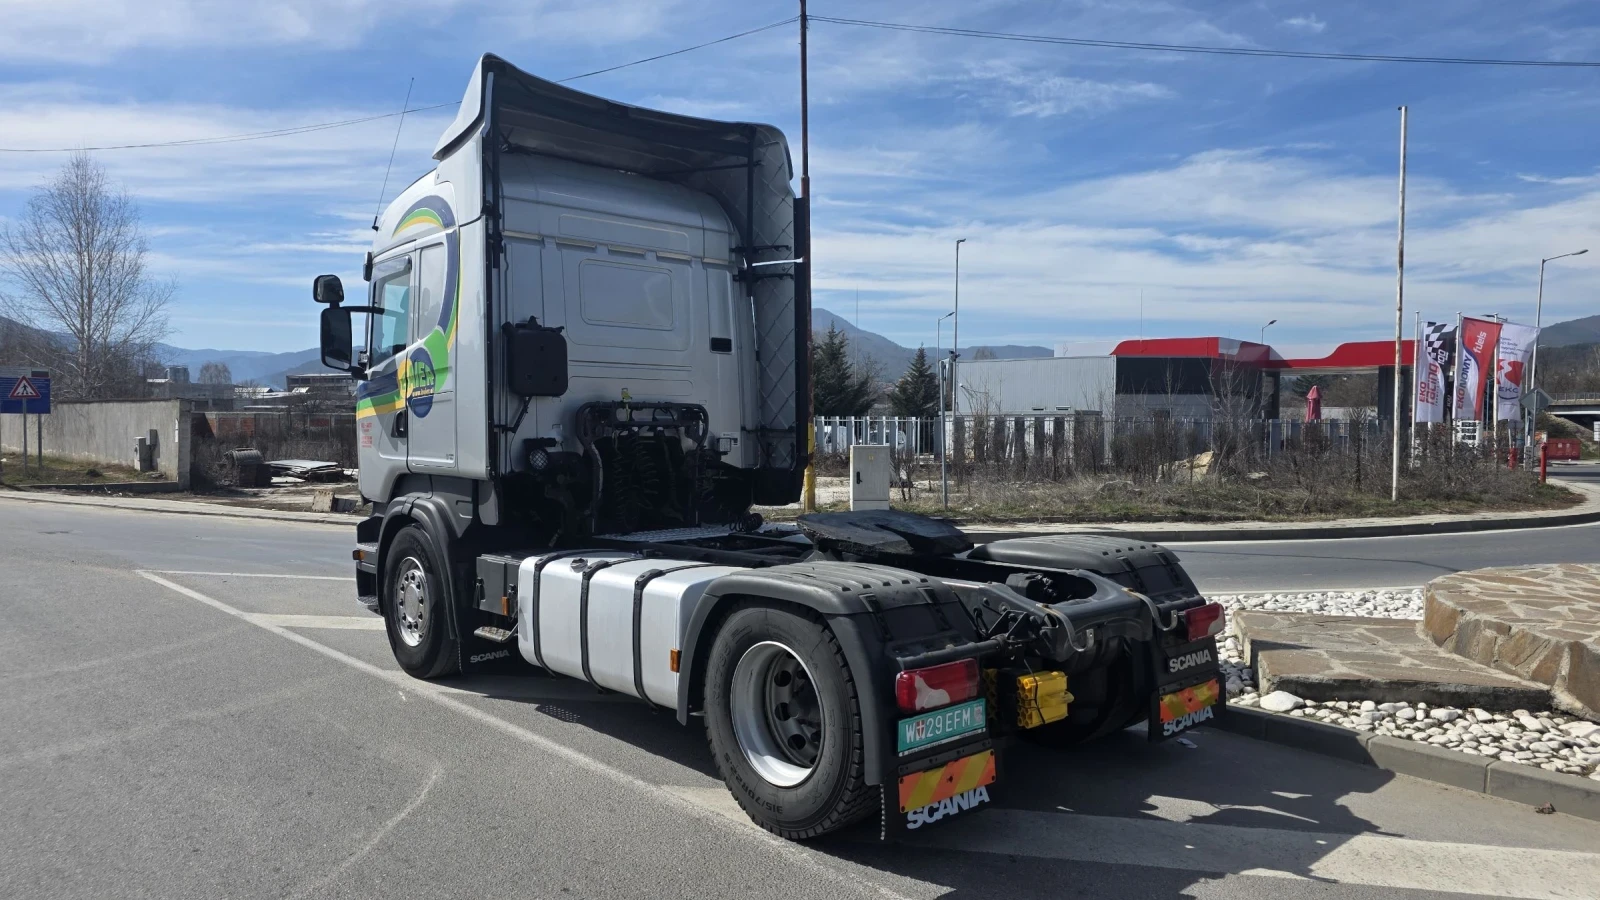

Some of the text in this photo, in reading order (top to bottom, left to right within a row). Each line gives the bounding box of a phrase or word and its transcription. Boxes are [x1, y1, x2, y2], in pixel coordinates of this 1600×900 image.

[1473, 331, 1487, 354] fuels
[1437, 349, 1447, 366] 100
[1419, 381, 1427, 403] EKO
[1426, 362, 1440, 406] racing
[1457, 354, 1472, 410] EKONOMY
[470, 650, 510, 663] SCANIA
[1169, 649, 1212, 673] SCANIA
[1163, 705, 1214, 736] SCANIA
[905, 722, 916, 744] W
[906, 785, 991, 830] SCANIA
